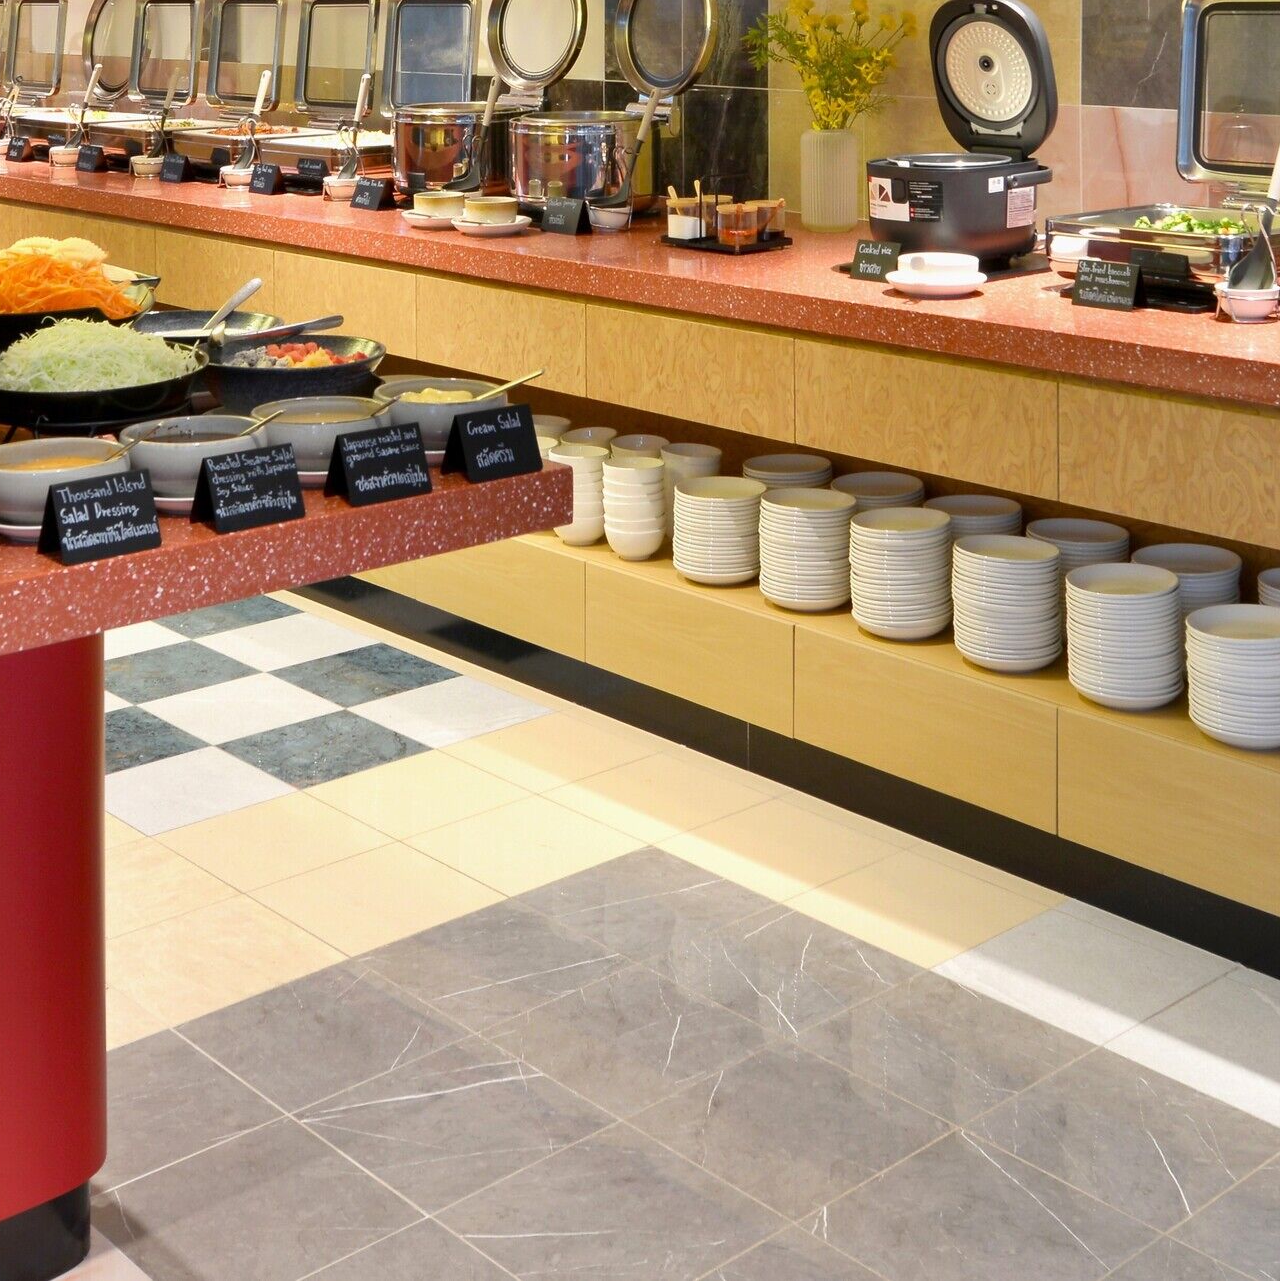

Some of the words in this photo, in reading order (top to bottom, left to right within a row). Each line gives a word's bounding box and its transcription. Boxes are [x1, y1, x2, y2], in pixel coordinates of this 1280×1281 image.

[859, 243, 881, 255] Cooked
[881, 246, 892, 255] rice
[1080, 273, 1093, 283] and
[466, 420, 497, 436] Cream
[497, 412, 521, 429] Salad
[343, 437, 377, 452] Japanese
[378, 428, 401, 443] roasted
[403, 427, 417, 439] and
[206, 453, 241, 471] Roasted
[272, 446, 294, 463] Salad
[346, 448, 375, 469] ground
[400, 443, 420, 453] Sauce
[212, 470, 246, 485] dressing
[264, 463, 297, 476] Japanese
[56, 481, 113, 503] Thousand
[216, 487, 230, 498] Soy
[231, 483, 255, 493] Sauce
[60, 503, 89, 524] Salad
[94, 501, 140, 519] Dressing
